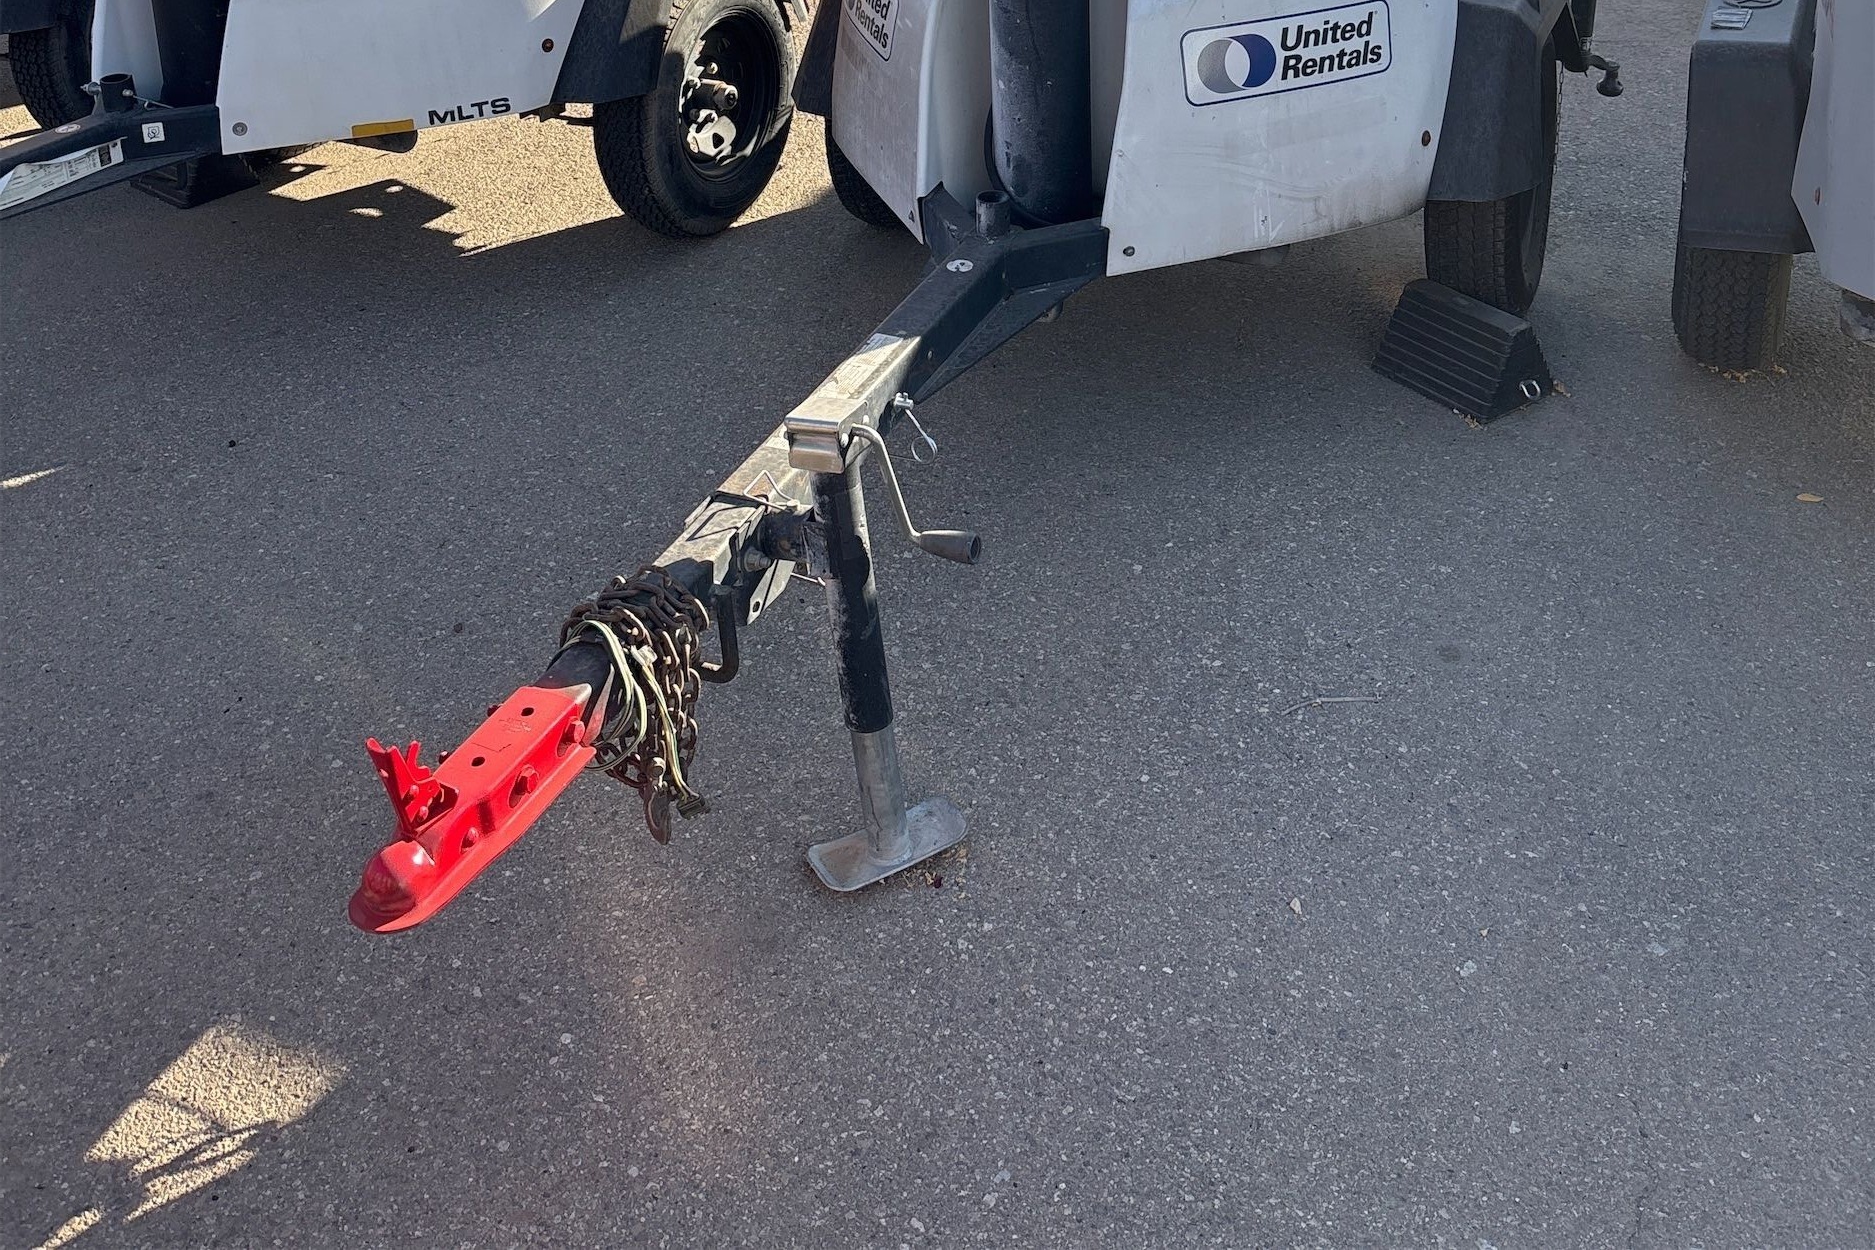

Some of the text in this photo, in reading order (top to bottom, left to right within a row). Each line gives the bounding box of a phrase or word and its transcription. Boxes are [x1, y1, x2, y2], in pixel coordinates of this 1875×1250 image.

[1279, 11, 1374, 52] United
[1280, 40, 1383, 81] Rentals
[427, 97, 511, 126] MLTS
